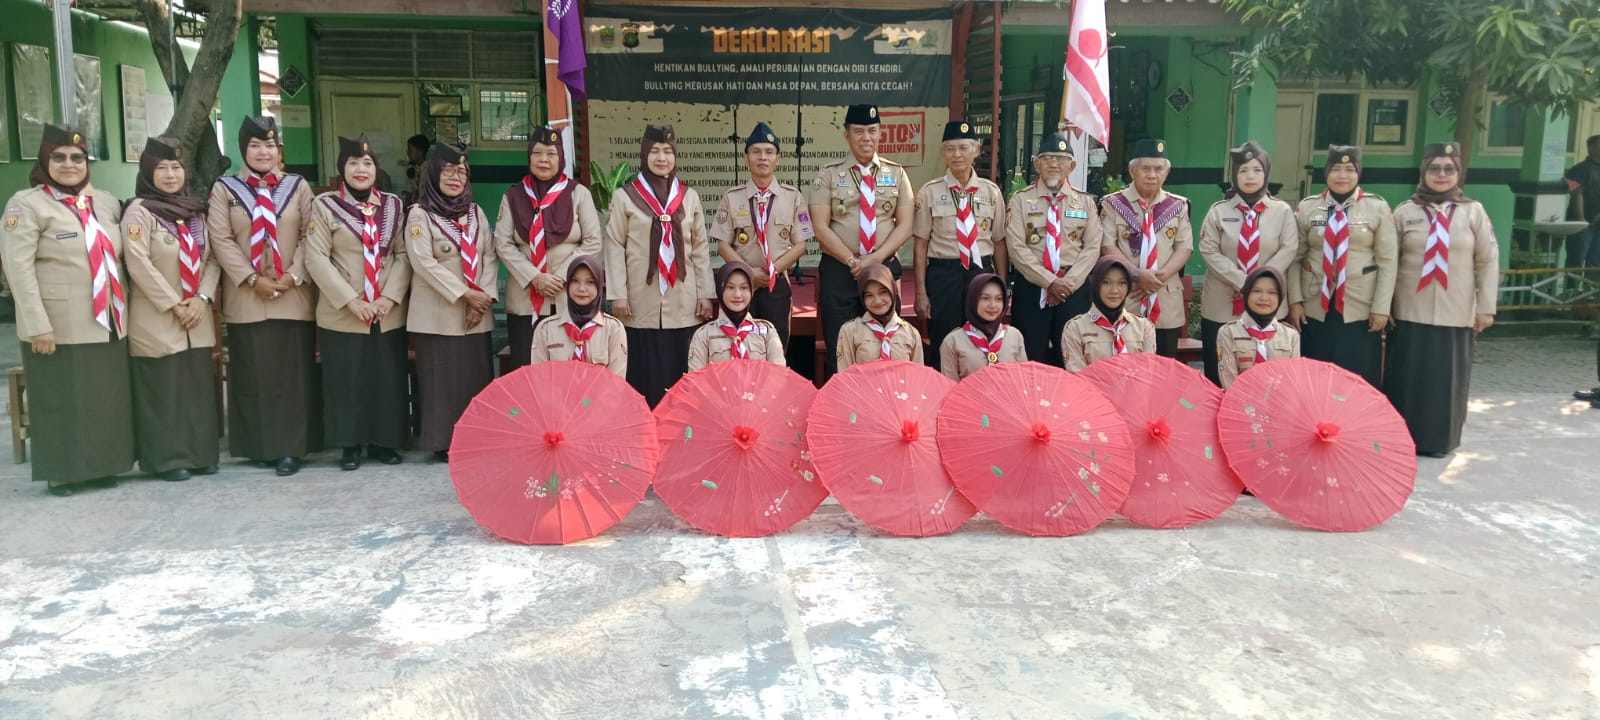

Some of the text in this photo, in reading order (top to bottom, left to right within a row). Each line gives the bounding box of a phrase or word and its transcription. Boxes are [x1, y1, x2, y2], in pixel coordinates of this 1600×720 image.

[713, 30, 830, 53] DEKLARASI
[654, 64, 696, 73] HENTIKAN
[697, 64, 738, 74] BULLYING,
[816, 64, 850, 73] DENGAN
[851, 64, 868, 73] DIRI
[869, 64, 903, 73] SENDIRI.
[644, 81, 683, 90] BULLYING
[684, 81, 724, 90] MERUSAK
[726, 81, 745, 90] HATI
[746, 81, 763, 90] DAN
[764, 81, 788, 90] MASA
[821, 81, 860, 90] BERSAMA
[861, 81, 880, 90] KITA
[881, 81, 908, 90] CEGAH
